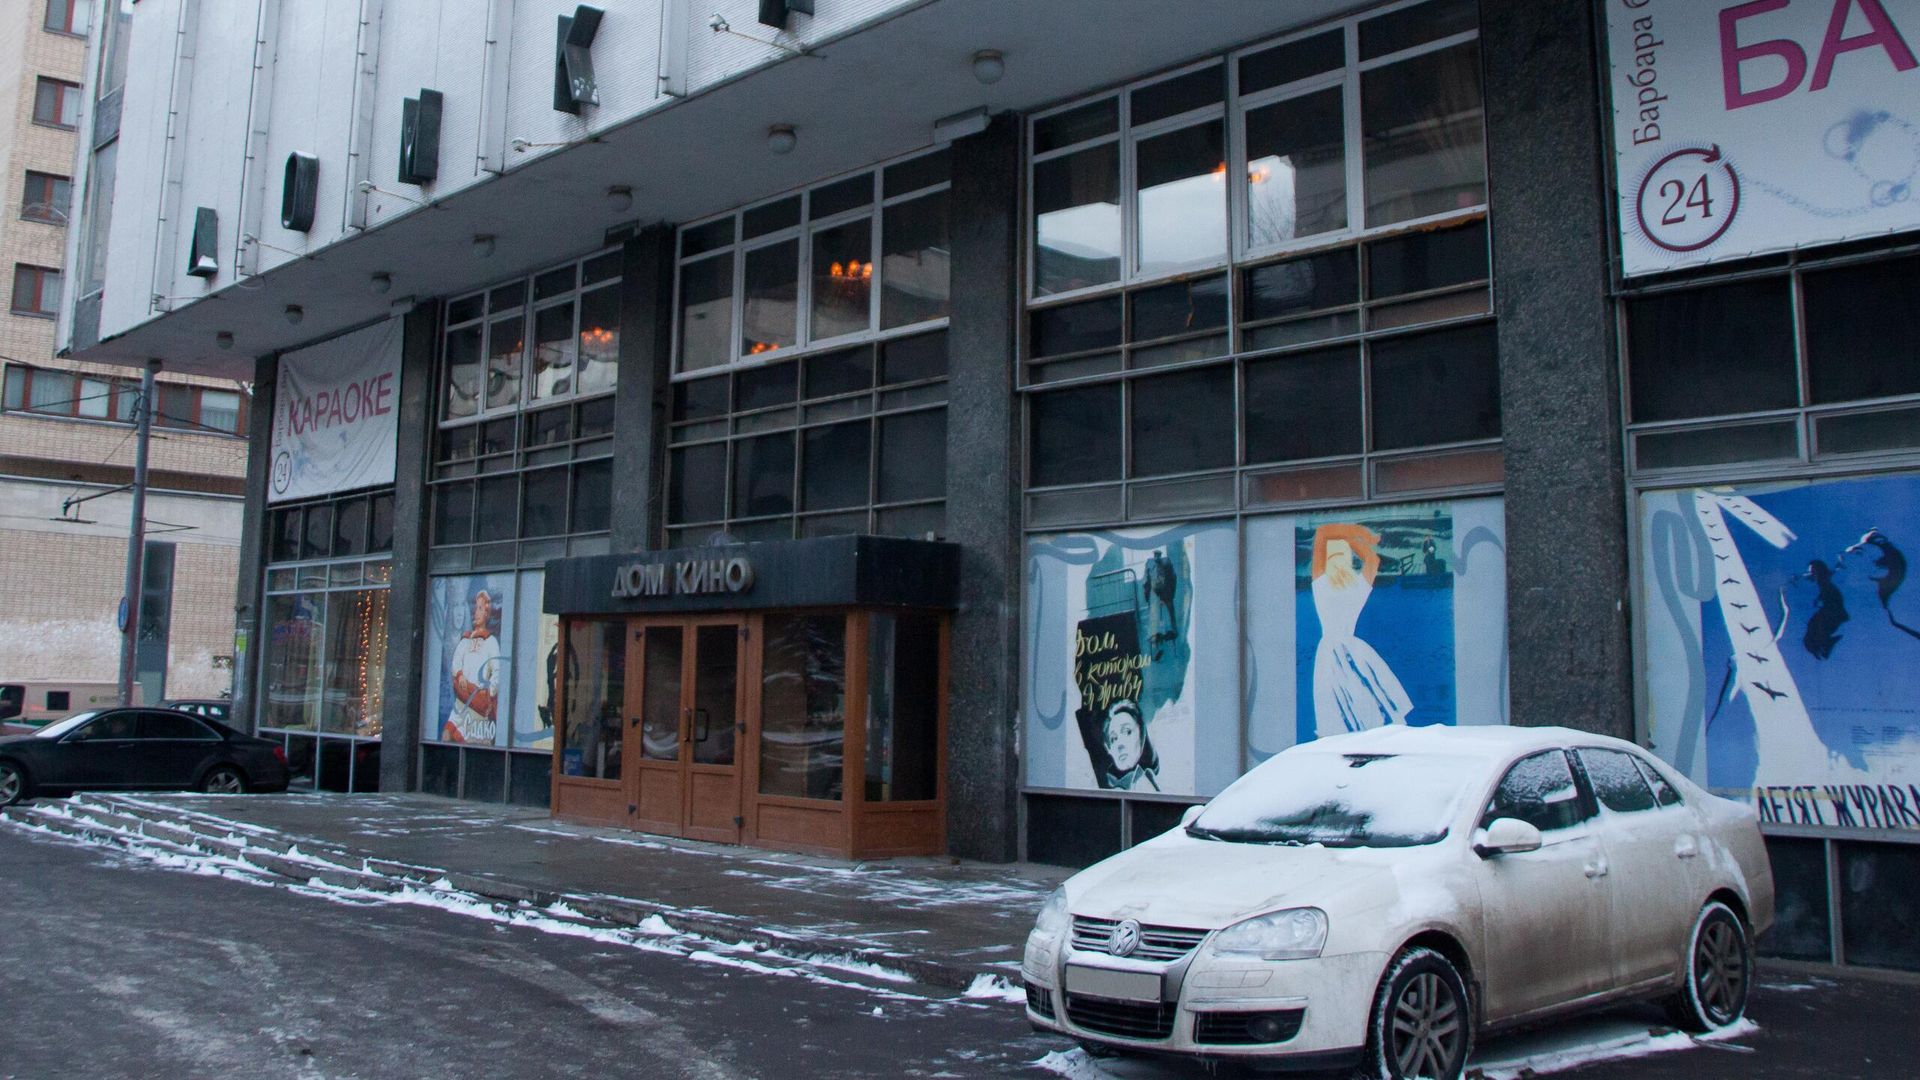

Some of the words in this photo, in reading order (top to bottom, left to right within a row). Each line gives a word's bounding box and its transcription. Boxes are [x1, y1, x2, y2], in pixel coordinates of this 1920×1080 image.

[1627, 15, 1668, 146] Барбара
[1658, 173, 1715, 226] 24
[287, 372, 393, 437] КАРАОКЕ
[611, 563, 667, 597] ДОМ
[675, 557, 754, 594] КИНО
